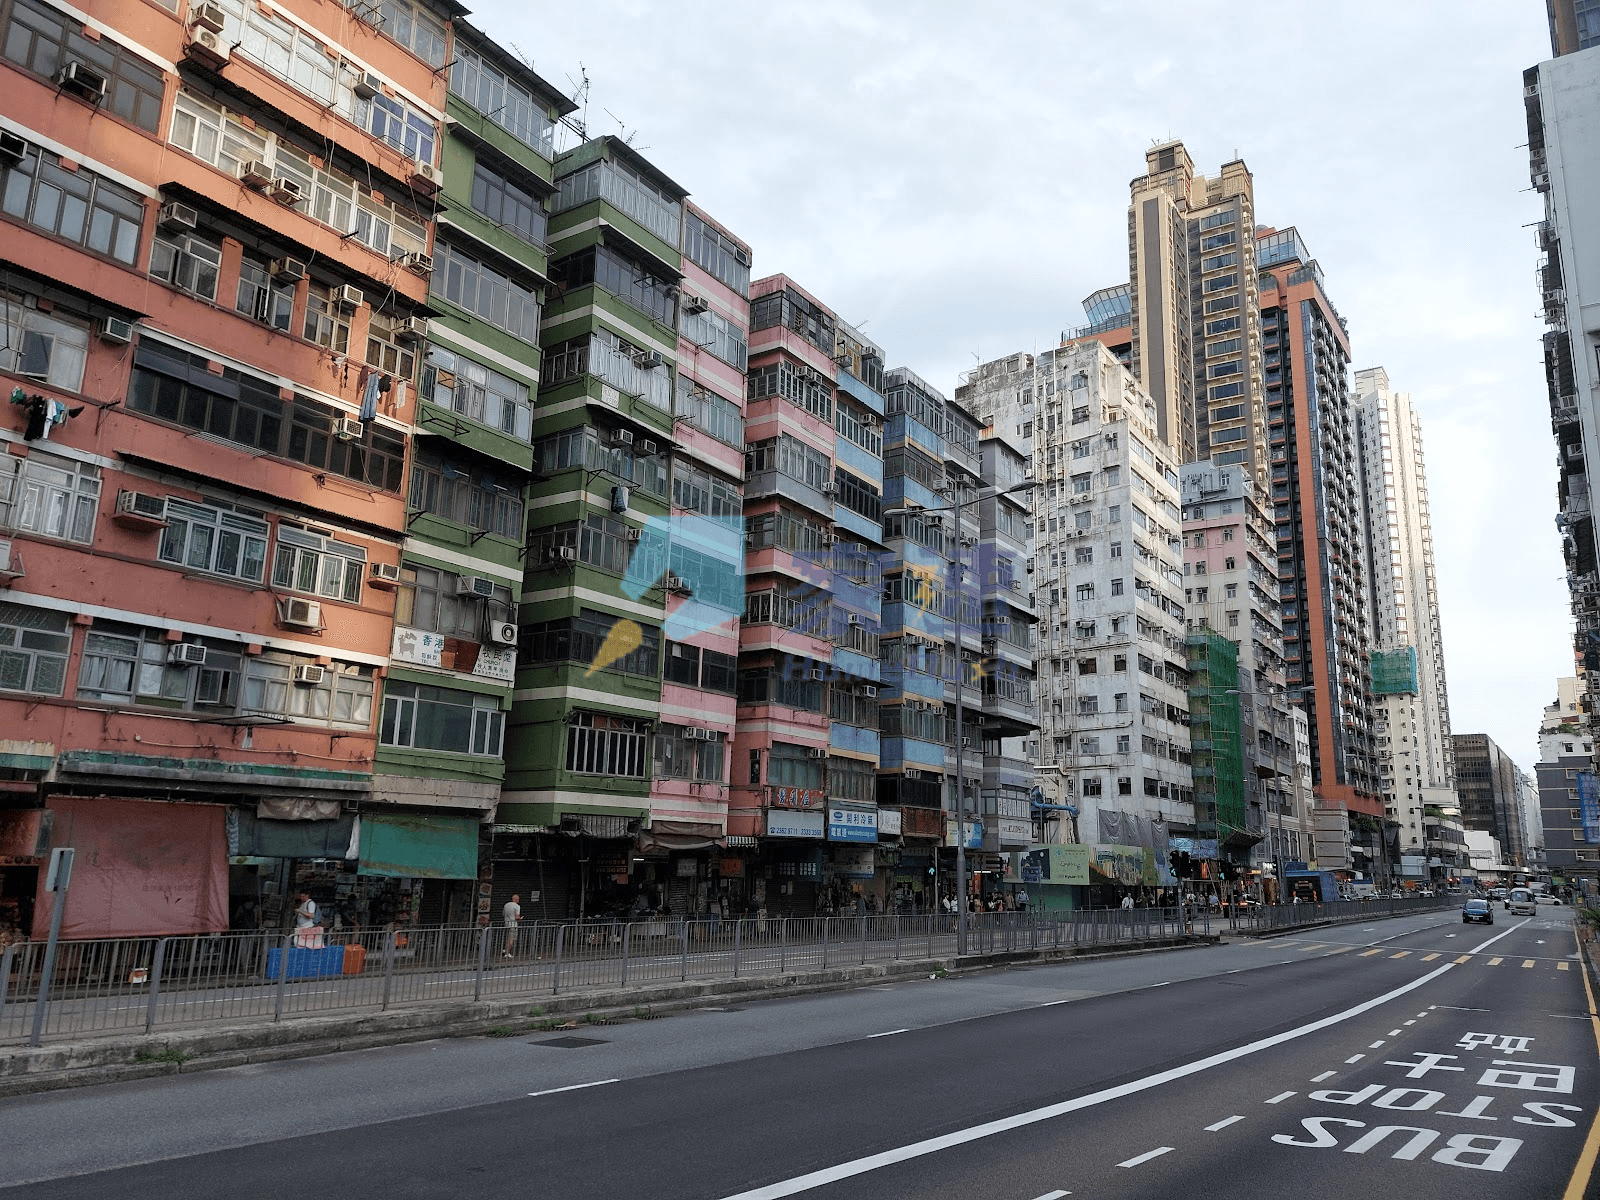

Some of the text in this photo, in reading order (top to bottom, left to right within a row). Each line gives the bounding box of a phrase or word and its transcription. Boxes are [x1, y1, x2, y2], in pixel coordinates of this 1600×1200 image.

[1455, 1031, 1535, 1054] 站
[1383, 1052, 1576, 1094] 巴士
[1307, 1084, 1583, 1127] STOP
[1271, 1116, 1524, 1172] BUS
